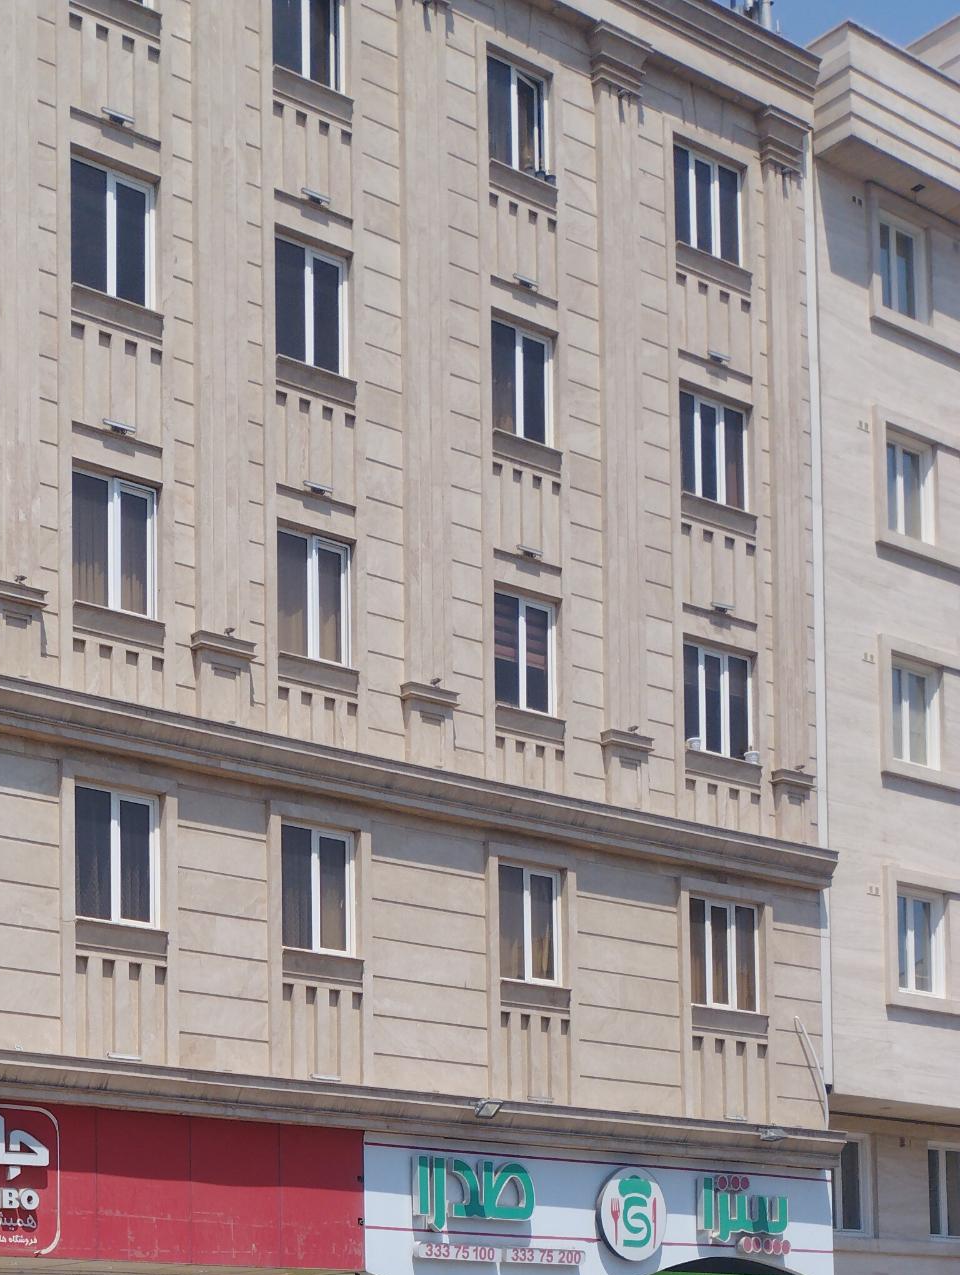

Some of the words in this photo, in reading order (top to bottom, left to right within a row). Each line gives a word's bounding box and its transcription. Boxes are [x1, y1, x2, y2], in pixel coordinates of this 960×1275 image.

[412, 1154, 537, 1231] صدرا
[8, 1234, 38, 1246] فروشگاه
[425, 1244, 451, 1259] 333
[454, 1245, 470, 1260] 75
[473, 1246, 496, 1262] 100
[512, 1247, 535, 1263] 333
[539, 1248, 554, 1263] 75
[558, 1248, 582, 1265] 200
